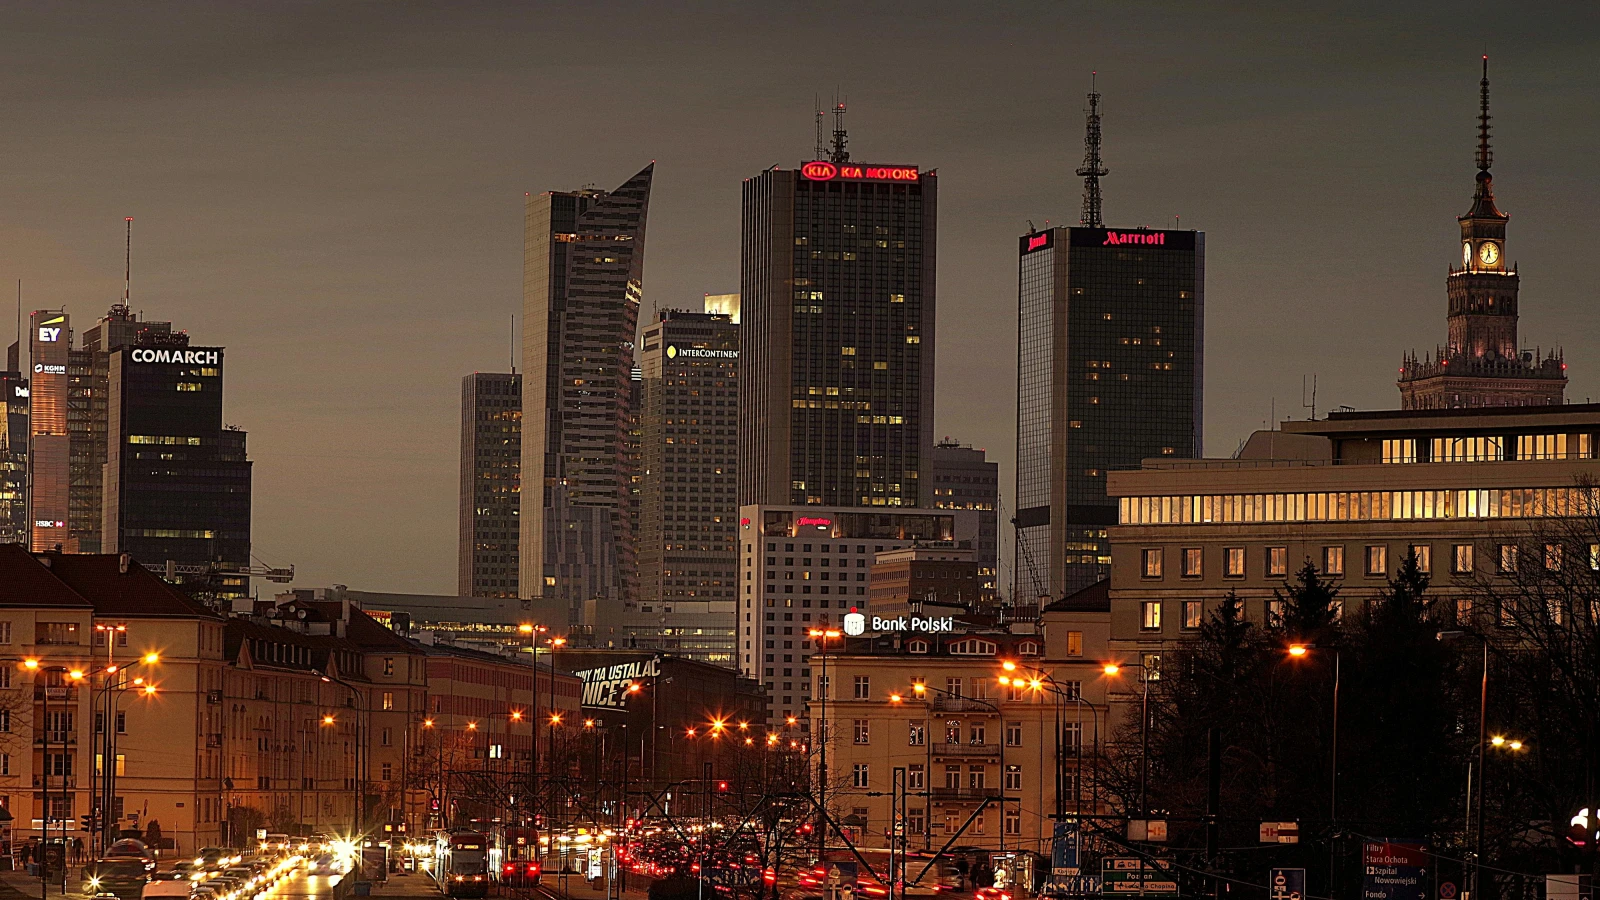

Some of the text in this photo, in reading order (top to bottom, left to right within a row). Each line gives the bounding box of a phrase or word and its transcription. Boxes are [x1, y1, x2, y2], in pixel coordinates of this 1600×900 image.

[807, 166, 831, 177] KIA
[841, 166, 919, 181] KIA MOTORS
[1102, 231, 1165, 246] Marriott
[38, 327, 61, 342] EY
[131, 348, 218, 365] COMARCH
[35, 520, 54, 528] HSBC
[872, 616, 953, 632] Bank Polski
[592, 666, 606, 681] MA
[608, 654, 661, 680] USTALAĆ
[1366, 855, 1408, 864] Stara Ochota
[1126, 872, 1153, 880] Pozań
[1375, 866, 1397, 876] Szpital
[1374, 876, 1417, 886] Nowowiejski
